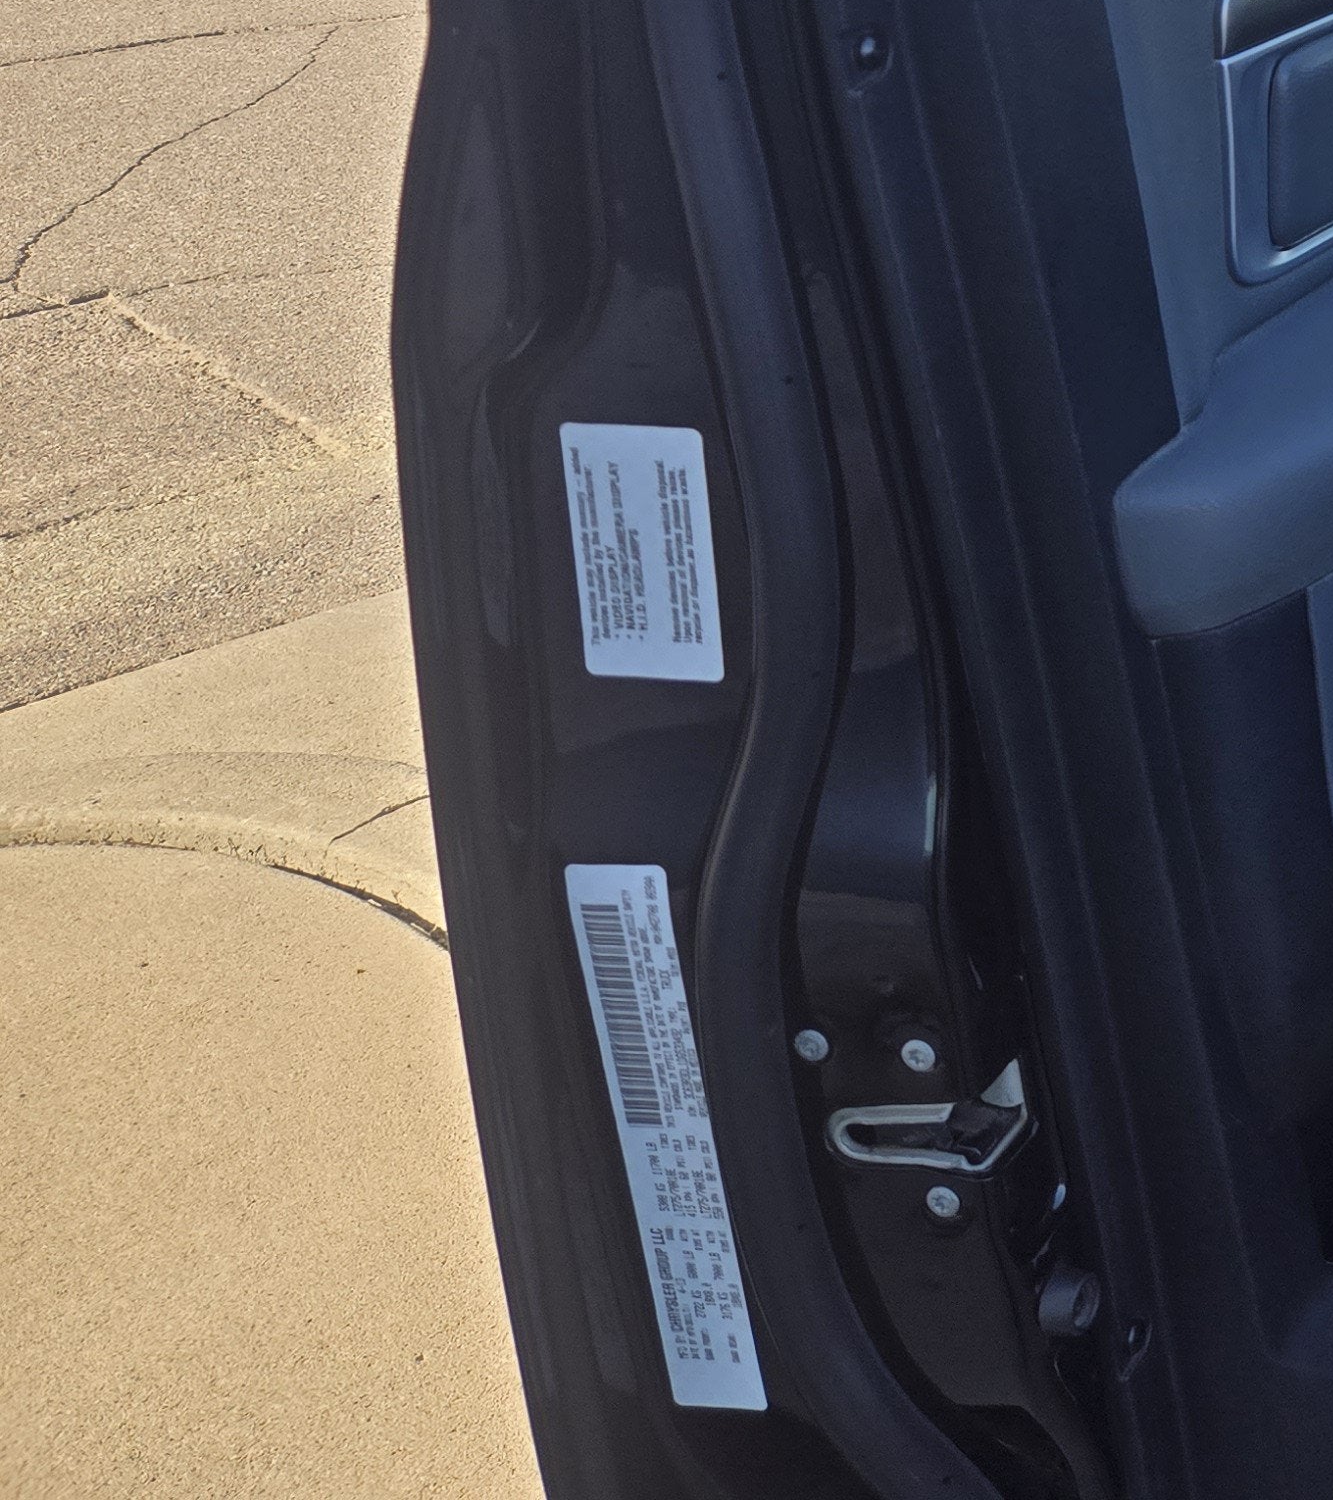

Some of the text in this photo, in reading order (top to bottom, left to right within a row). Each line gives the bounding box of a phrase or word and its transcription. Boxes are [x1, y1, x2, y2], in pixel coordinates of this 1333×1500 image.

[605, 546, 624, 629] VIDEO DISPLAY
[649, 1228, 665, 1245] LLC
[654, 1248, 673, 1281] GROUP
[662, 1283, 683, 1332] CHRYSLER
[693, 1301, 707, 1318] 2722
